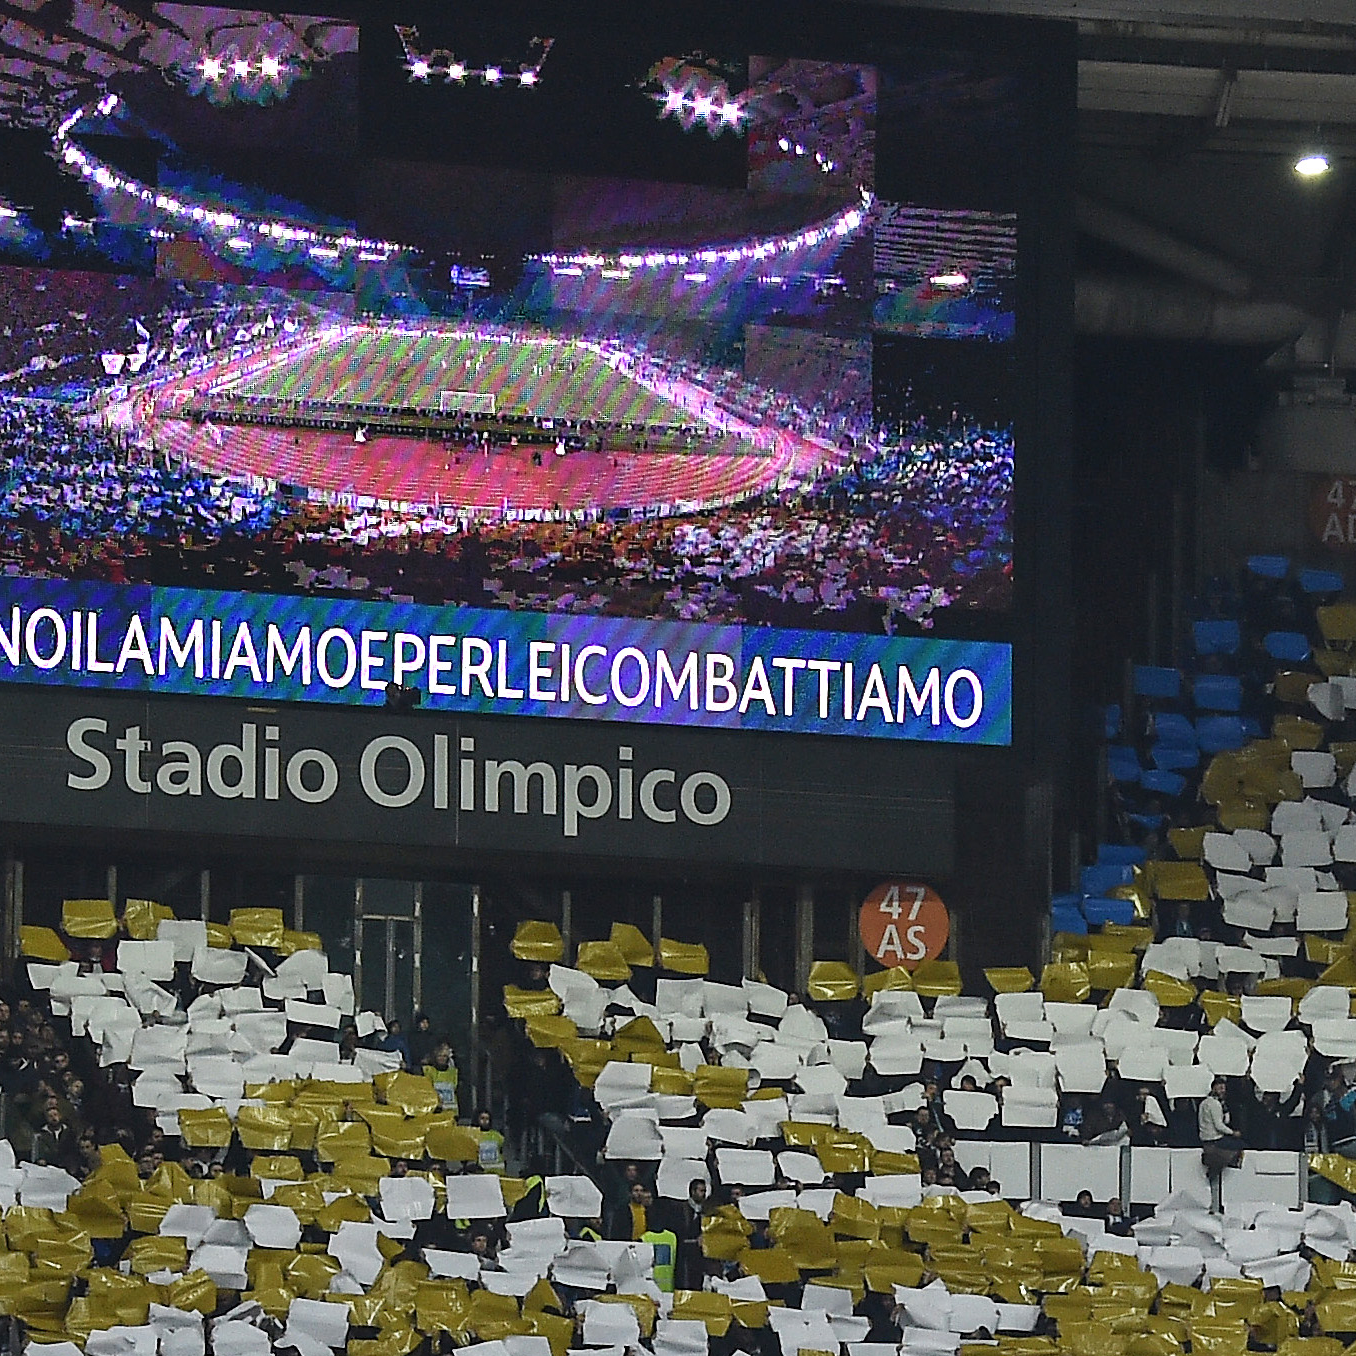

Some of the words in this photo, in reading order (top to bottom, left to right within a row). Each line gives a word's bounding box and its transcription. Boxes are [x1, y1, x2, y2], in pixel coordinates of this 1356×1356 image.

[66, 717, 339, 804] Stadio
[359, 733, 731, 838] Olimpico
[879, 886, 926, 920] 47
[876, 924, 928, 961] AS
